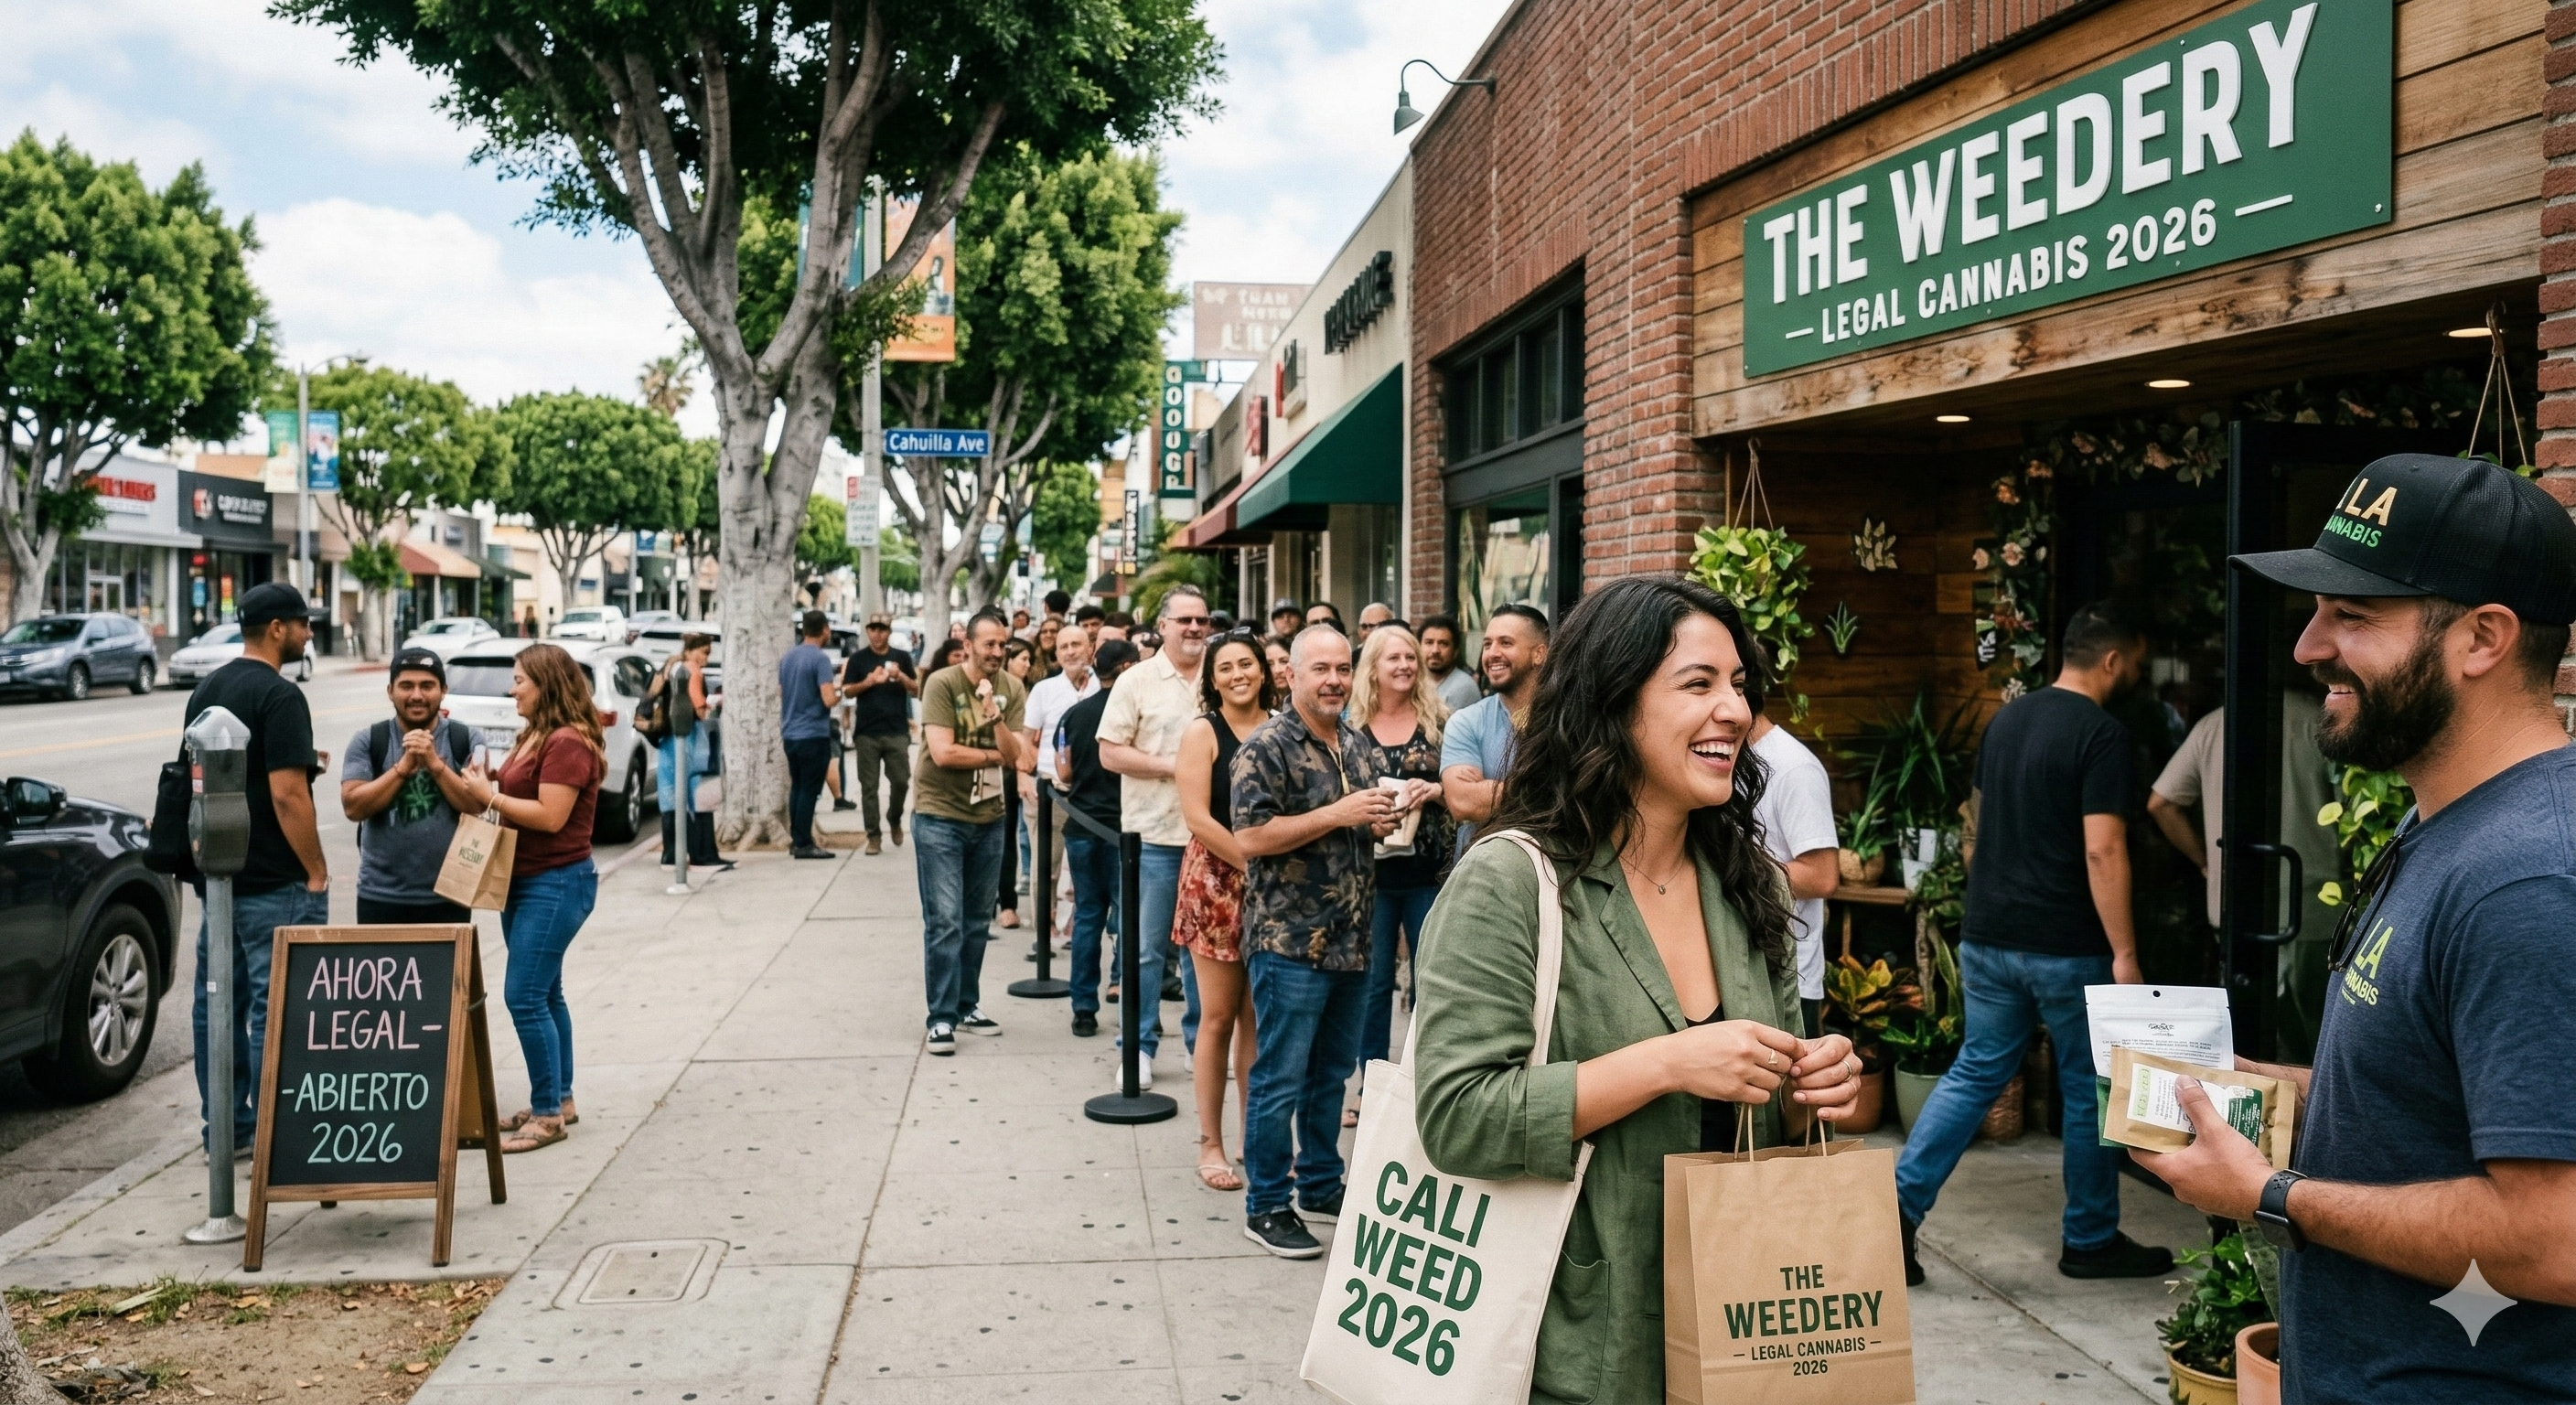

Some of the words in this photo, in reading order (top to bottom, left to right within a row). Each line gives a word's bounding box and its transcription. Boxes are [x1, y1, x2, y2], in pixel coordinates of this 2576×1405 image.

[1764, 184, 1869, 305] THE
[1890, 2, 2320, 264] WEEDERY
[1821, 288, 1906, 345] LEGAL
[1919, 235, 2089, 319] CANNABIS
[2106, 198, 2217, 273] 2026
[889, 433, 952, 451] Cahuilla
[957, 434, 985, 452] Ave
[2354, 917, 2393, 980] LA
[307, 957, 422, 1001] AHORA
[307, 1122, 402, 1164] 2026
[1376, 1161, 1491, 1249] CALI
[1354, 1213, 1482, 1312] WEED
[1779, 1264, 1825, 1291] THE
[1337, 1278, 1460, 1376] 2026
[1723, 1291, 1883, 1339] WEEDERY
[1751, 1344, 1794, 1360] LEGAL
[1798, 1336, 1865, 1357] CANNABIS
[1793, 1360, 1829, 1376] 2026
